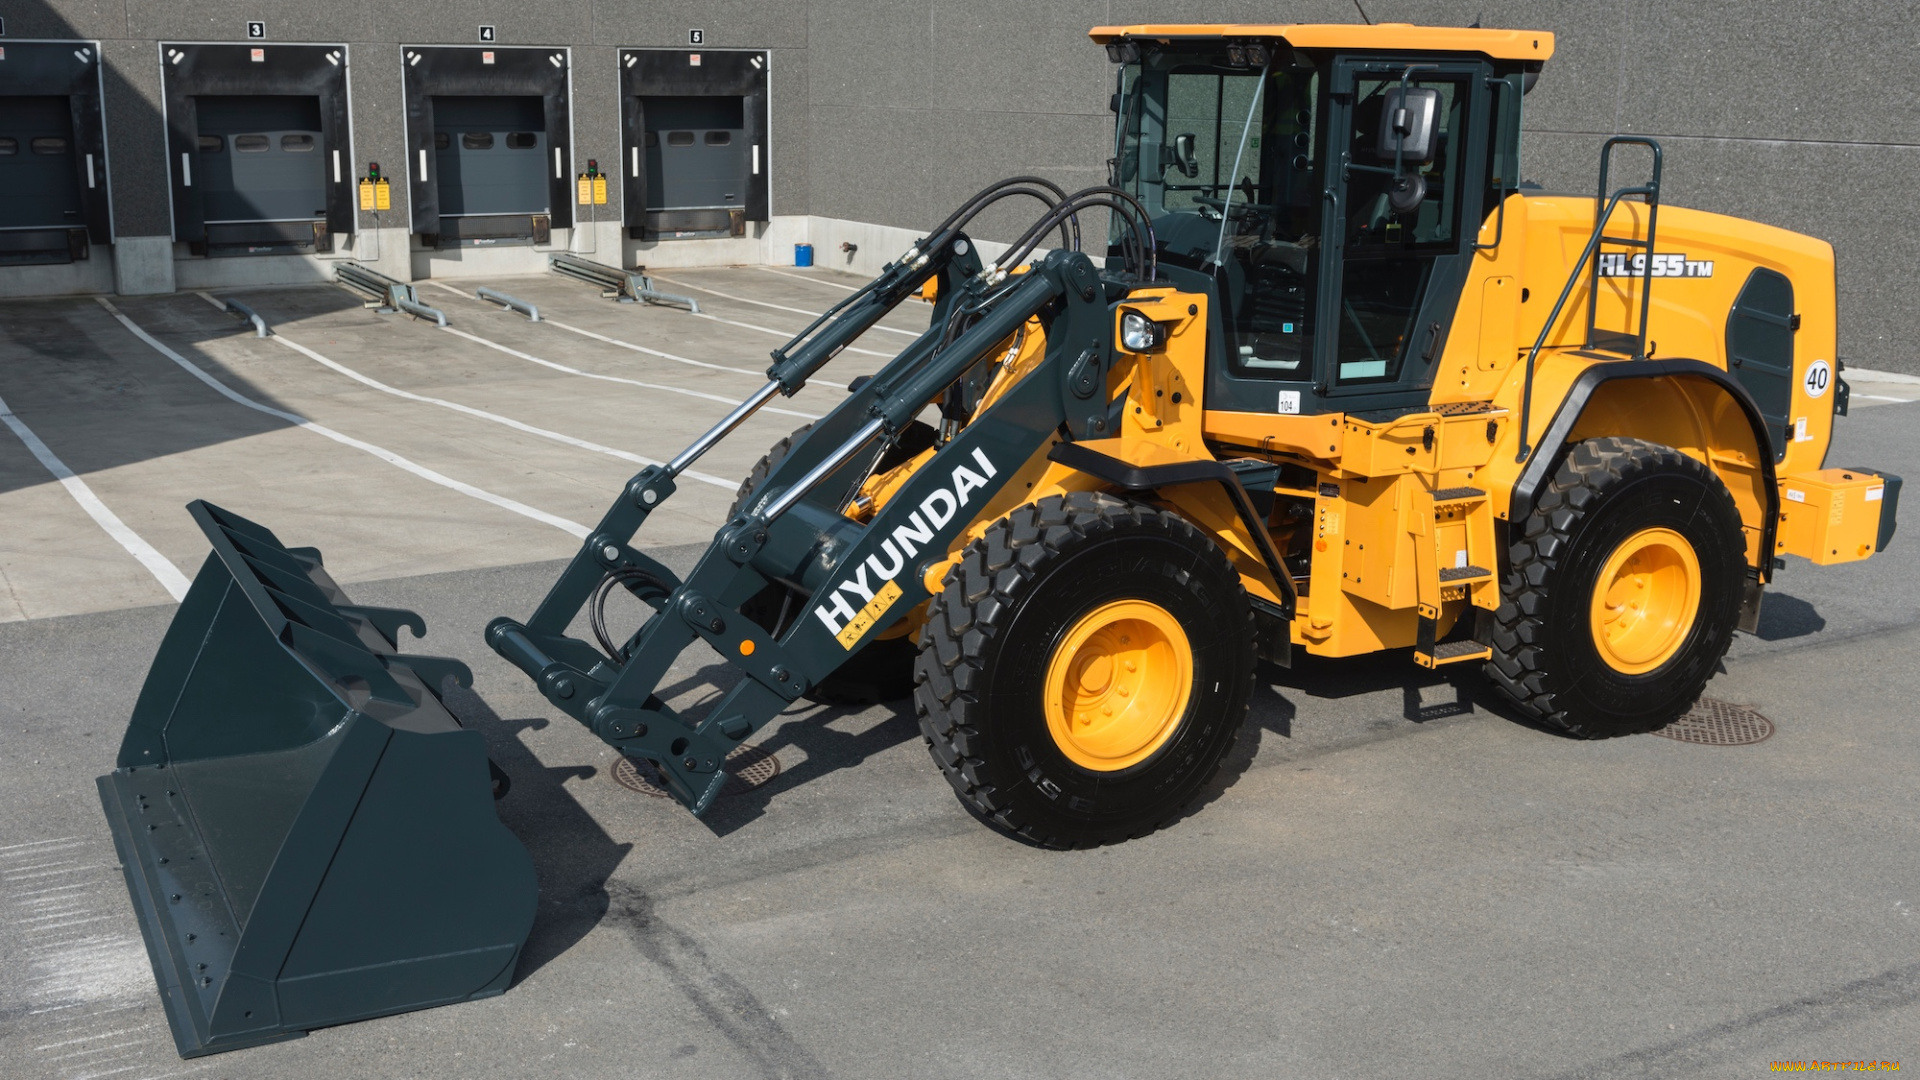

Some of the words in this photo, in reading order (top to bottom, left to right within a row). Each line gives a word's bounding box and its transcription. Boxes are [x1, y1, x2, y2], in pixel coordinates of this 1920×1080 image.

[252, 25, 261, 36] 3
[482, 28, 492, 40] 4
[693, 31, 701, 43] 5
[1807, 368, 1827, 390] 40
[1280, 400, 1293, 412] 104
[814, 446, 998, 637] HYUNDAI
